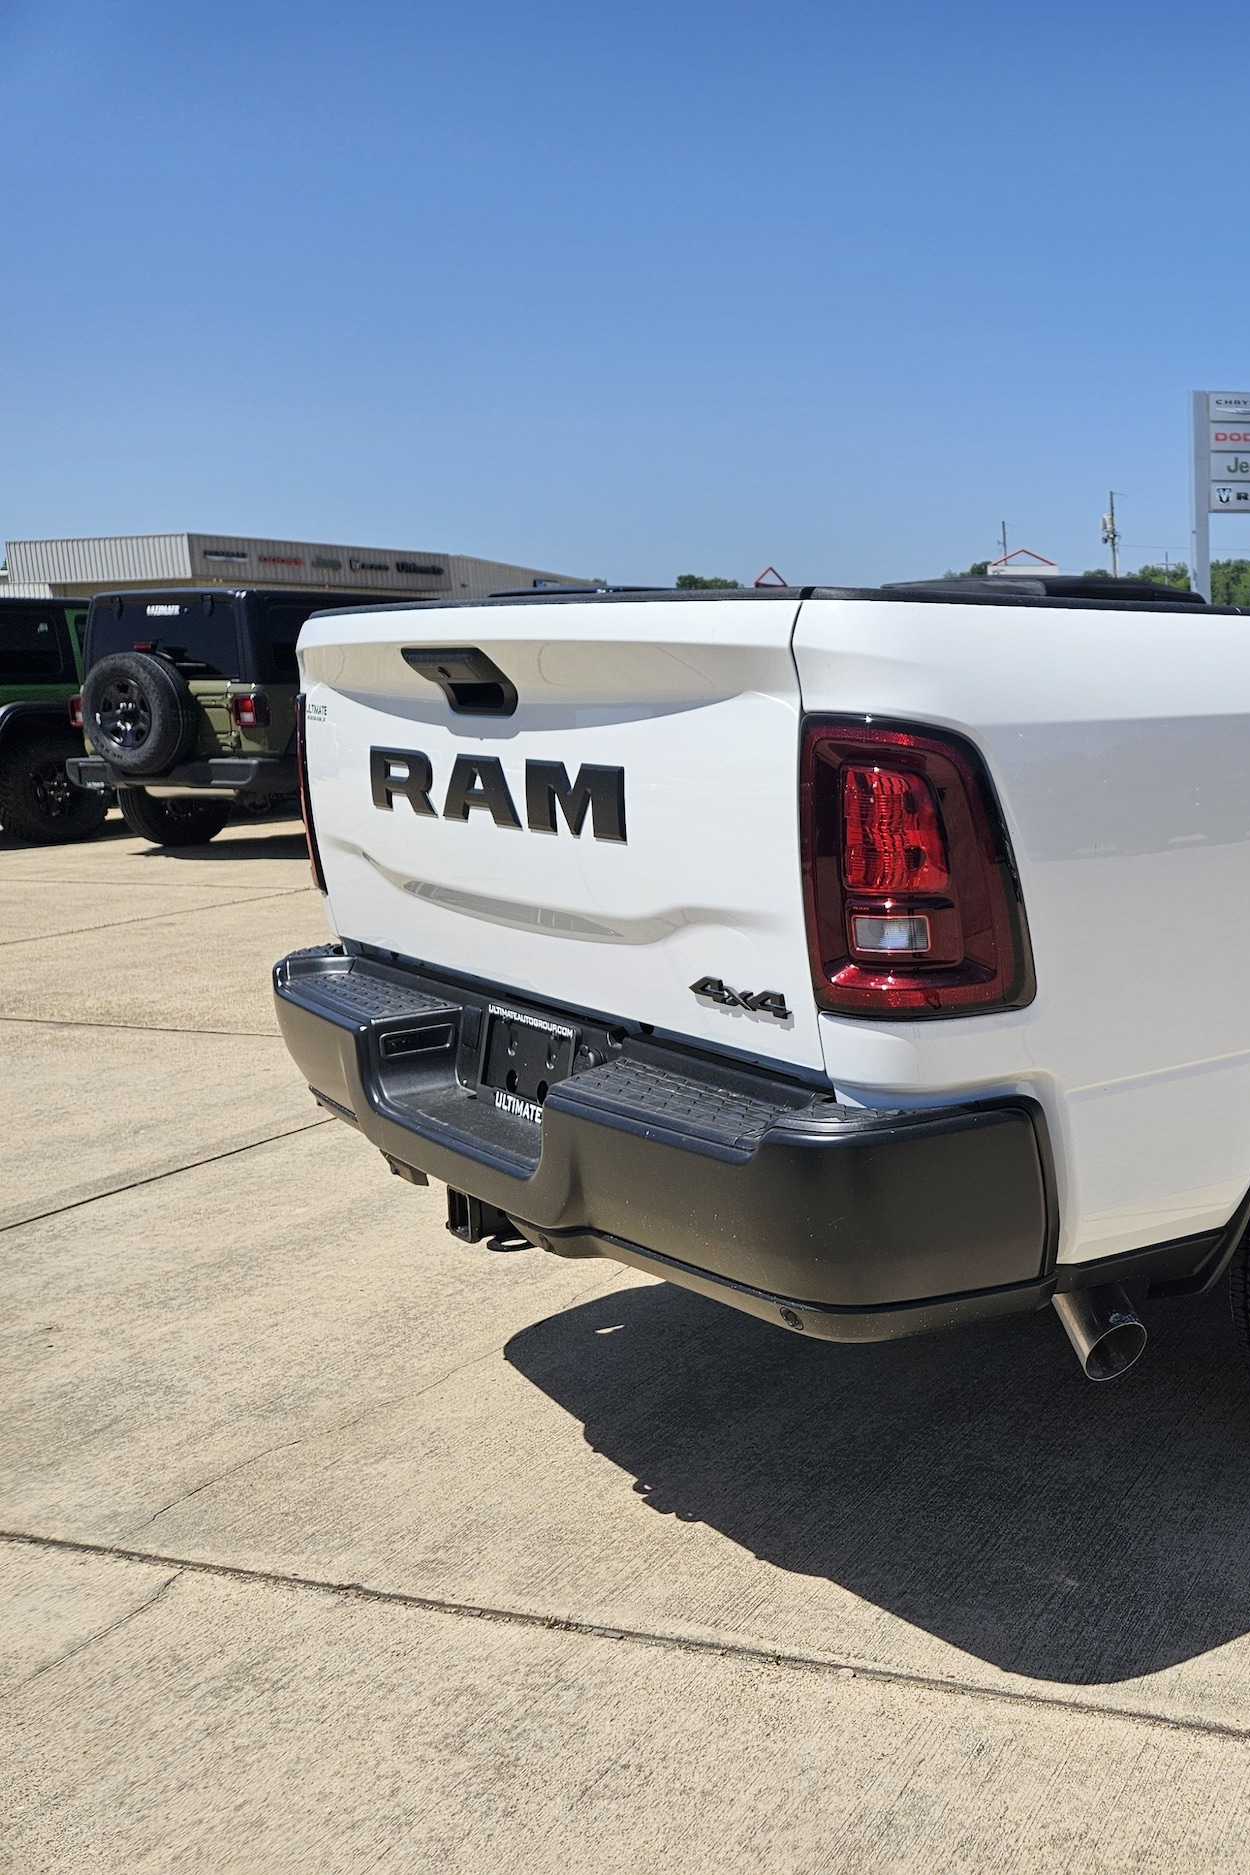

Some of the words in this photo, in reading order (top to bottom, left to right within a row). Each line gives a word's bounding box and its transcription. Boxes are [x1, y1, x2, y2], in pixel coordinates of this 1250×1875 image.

[370, 746, 628, 844] RAM
[488, 1003, 574, 1039] ULTIMATEAUTOGROUP.COM
[495, 1090, 543, 1125] ULTIMATE
